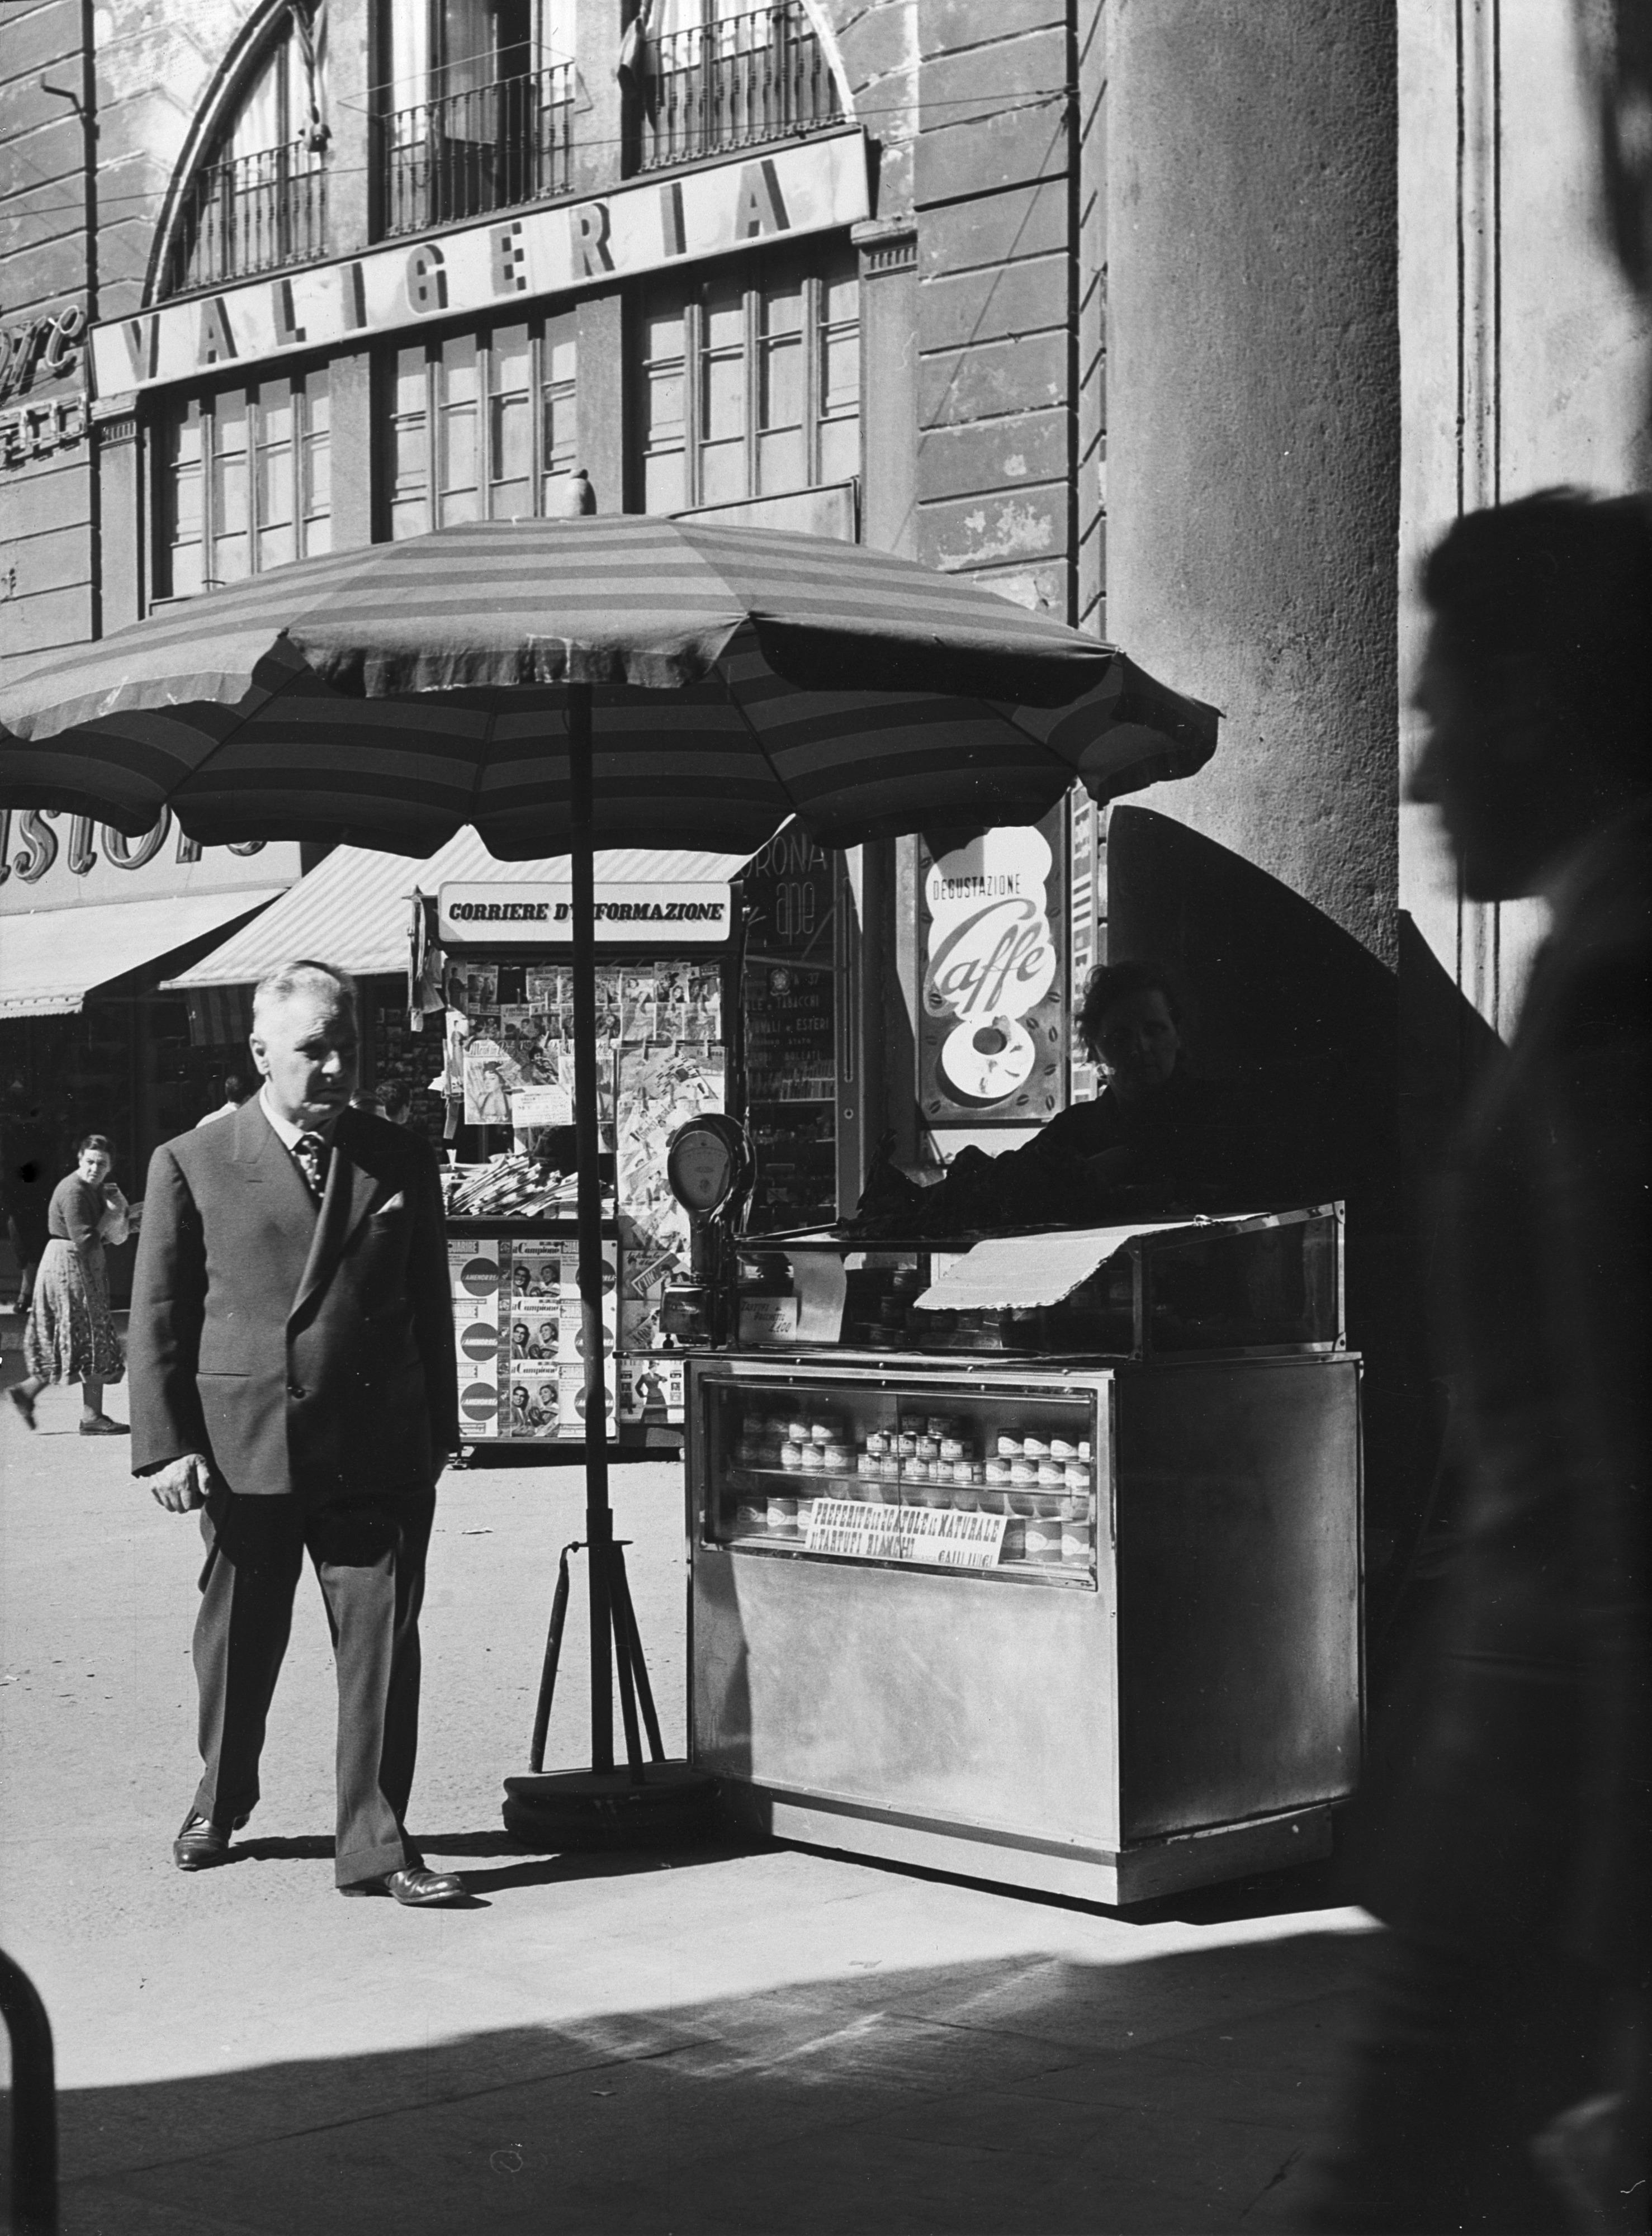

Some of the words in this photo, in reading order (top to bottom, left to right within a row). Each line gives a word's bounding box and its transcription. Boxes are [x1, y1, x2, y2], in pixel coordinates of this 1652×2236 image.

[121, 159, 791, 380] VALIGERIA
[933, 874, 1021, 901] DEGUSTAZIONE
[448, 903, 550, 921] CORRIERE
[553, 902, 725, 921] D'FORMAZIONE
[796, 1017, 830, 1031] ESTERI
[518, 1242, 560, 1256] Campione
[517, 1300, 558, 1313] Campione
[517, 1363, 558, 1375] Campione
[815, 1502, 873, 1530] PREFERITE
[881, 1509, 929, 1536] SCATOLE
[938, 1514, 1001, 1543] NATURALE
[818, 1528, 863, 1554] TARTUFI
[867, 1533, 915, 1558] BIANCHI
